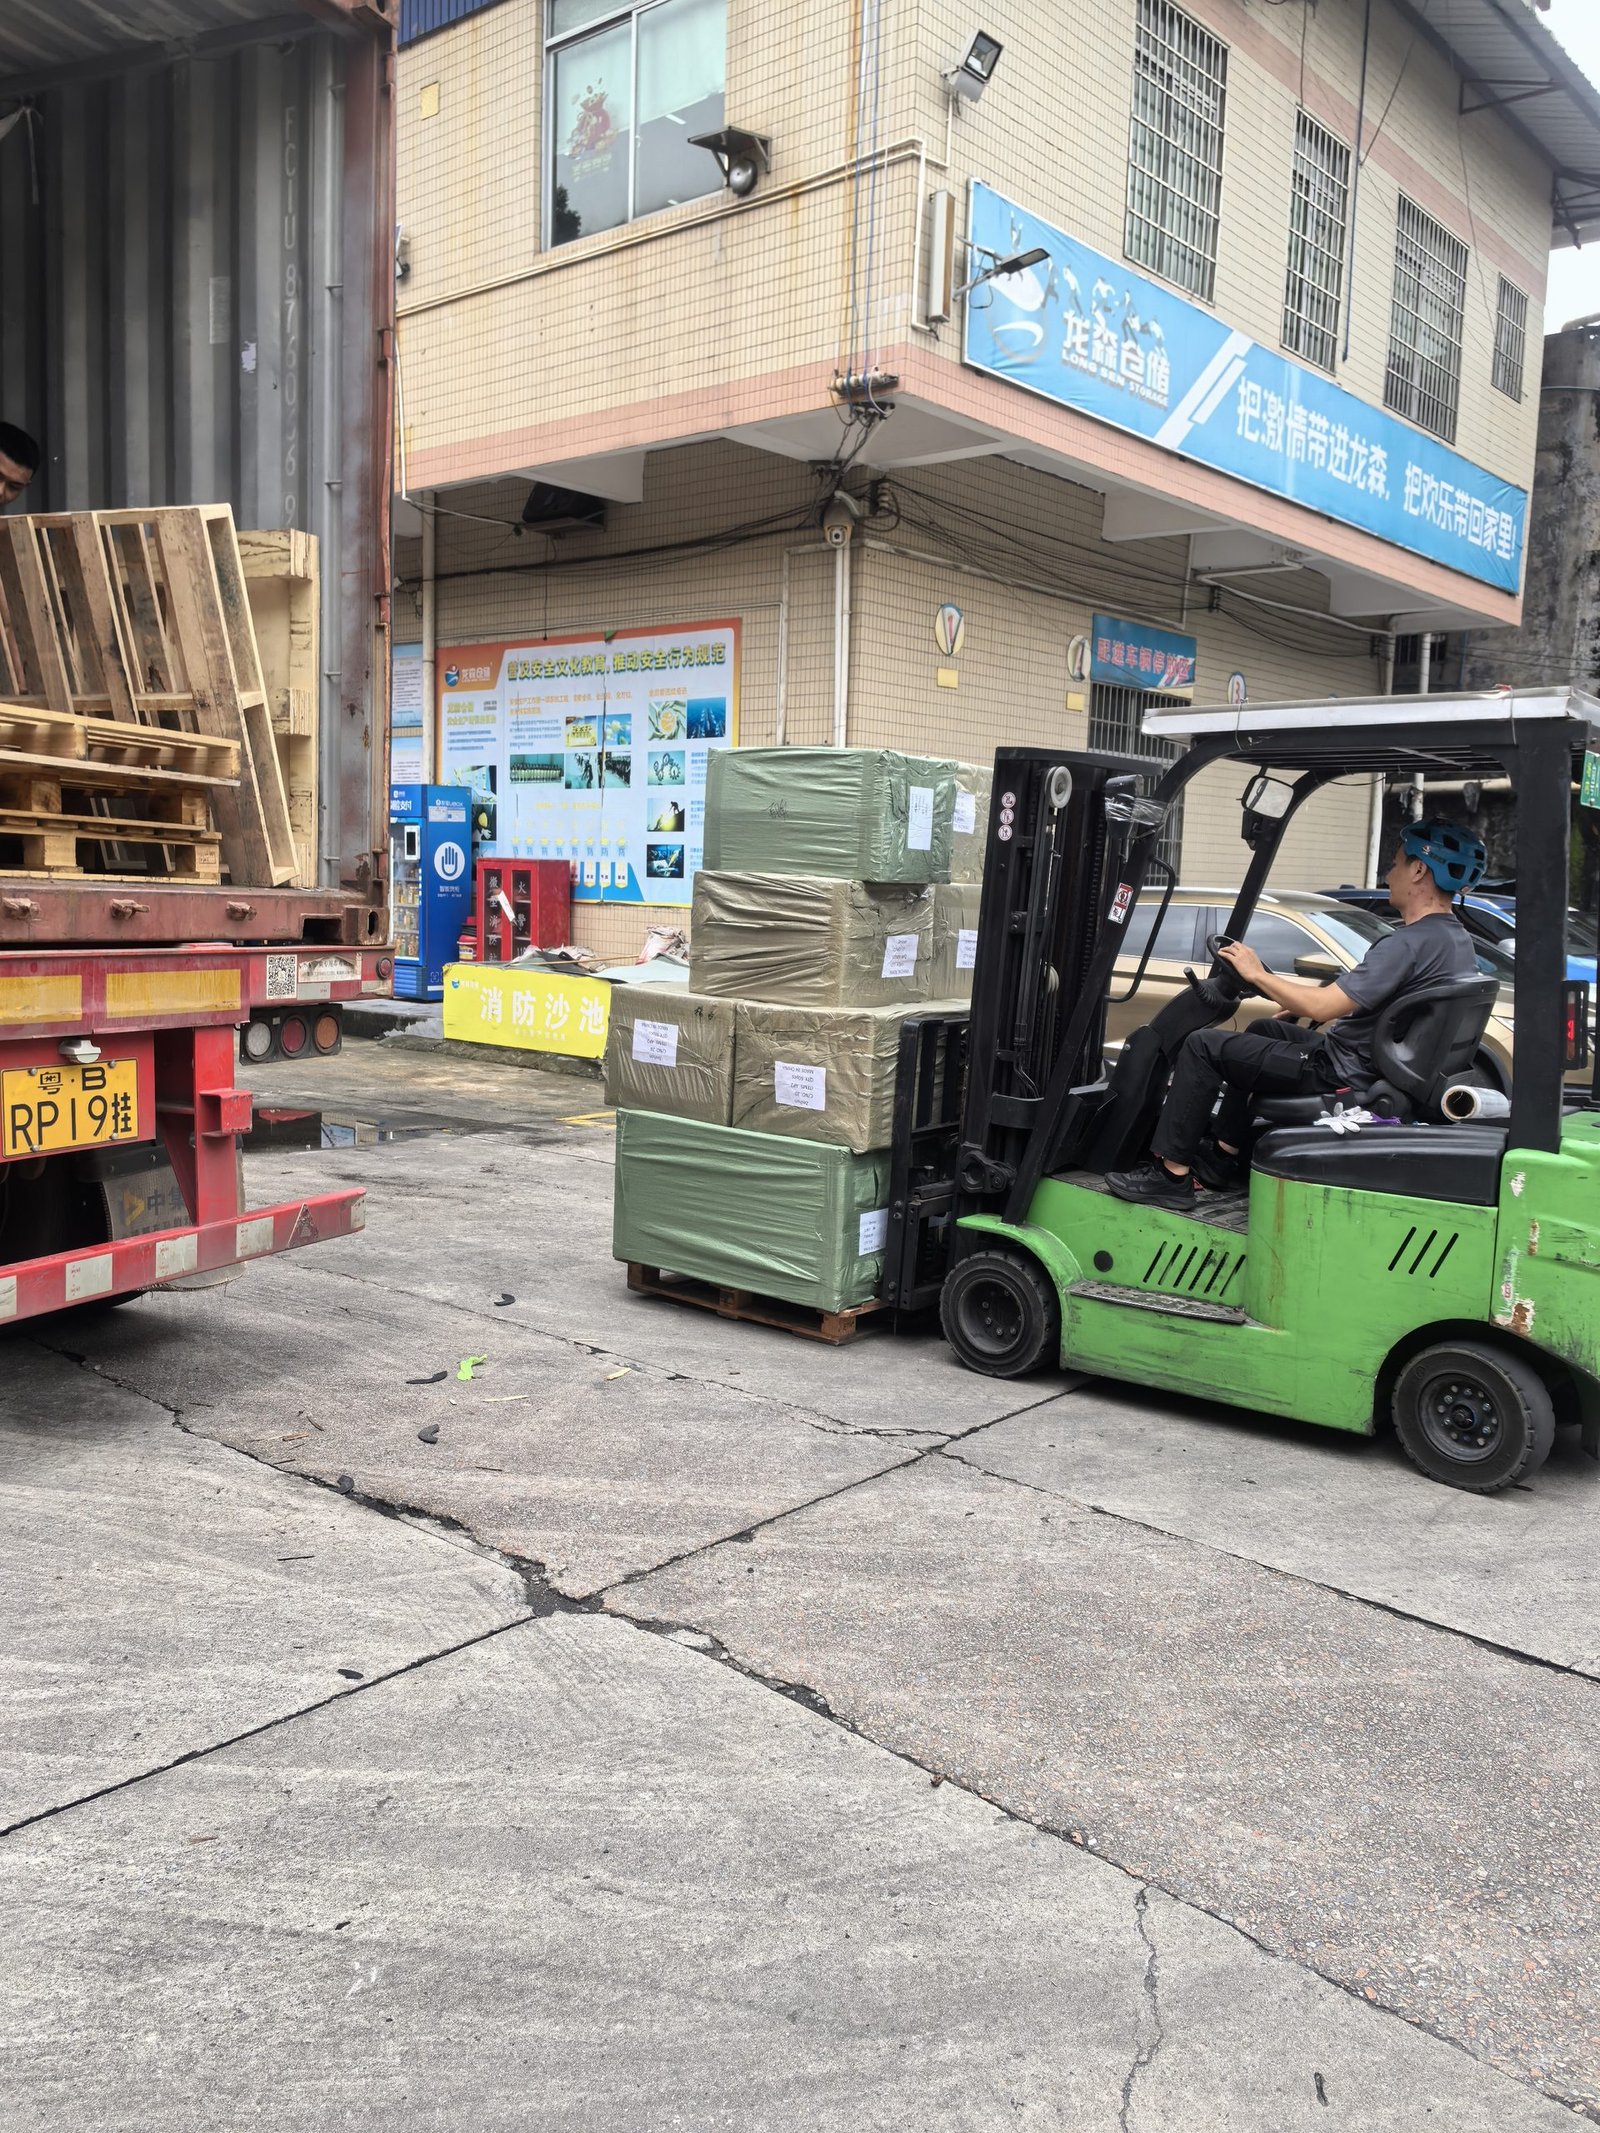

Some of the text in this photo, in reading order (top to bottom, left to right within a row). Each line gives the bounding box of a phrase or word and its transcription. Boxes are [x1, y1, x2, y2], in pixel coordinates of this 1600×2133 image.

[1062, 310, 1169, 396] 龙森仓储
[285, 494, 296, 526] 9
[480, 985, 605, 1035] 消防沙池
[11, 1092, 132, 1150] RP19挂
